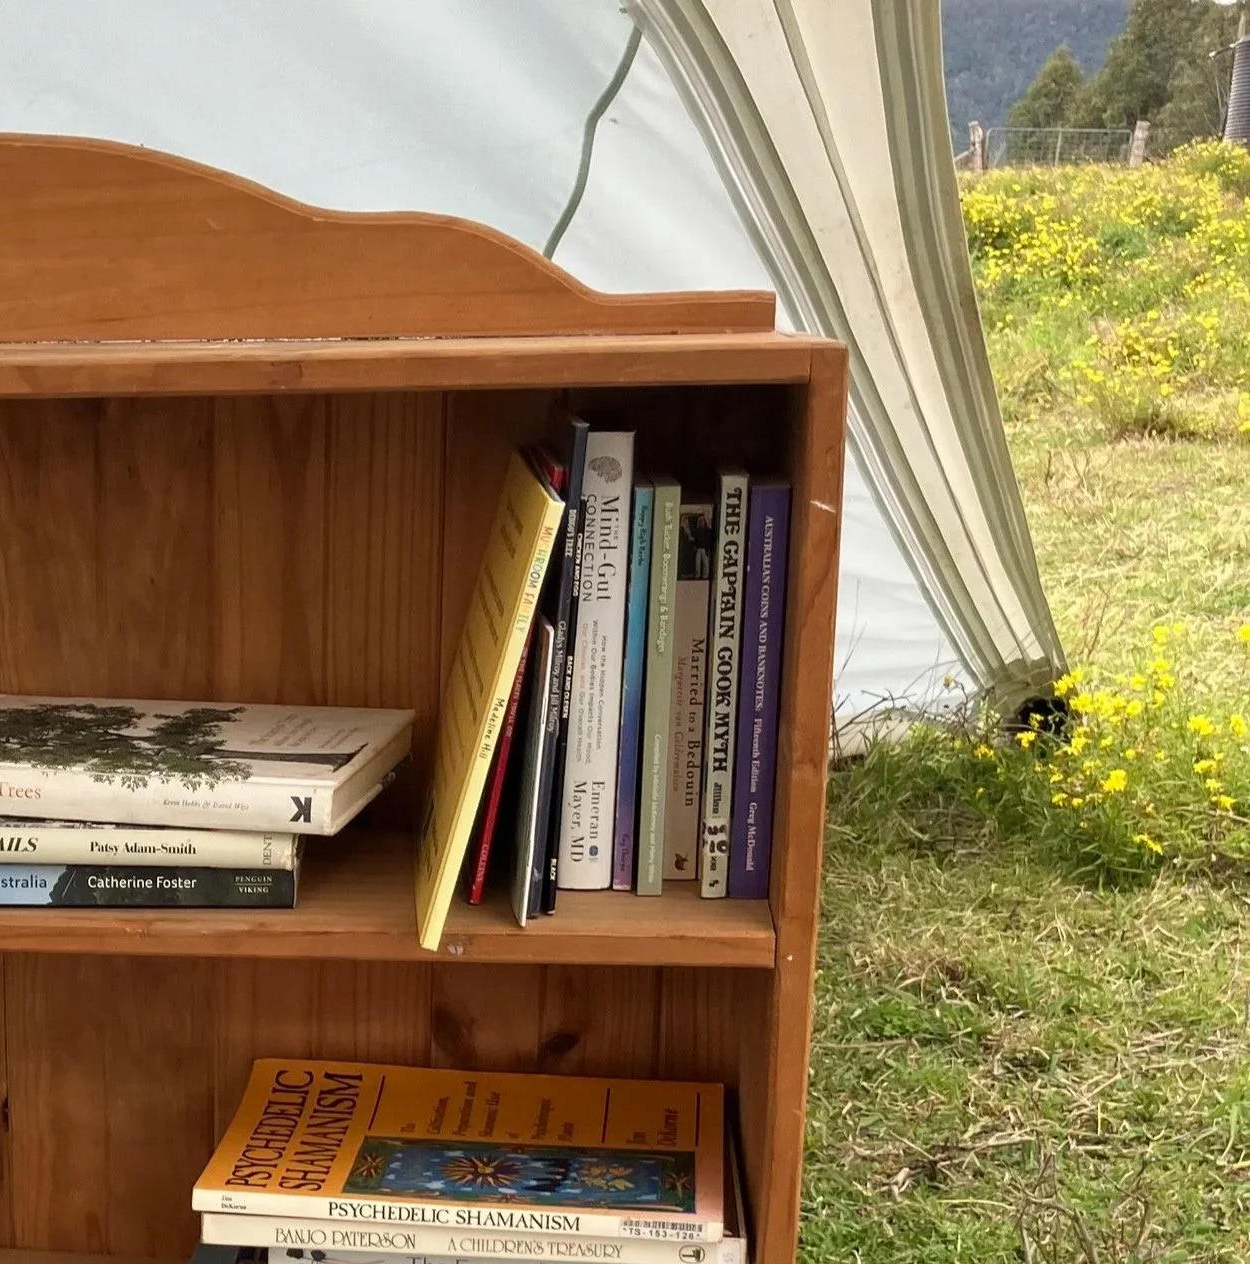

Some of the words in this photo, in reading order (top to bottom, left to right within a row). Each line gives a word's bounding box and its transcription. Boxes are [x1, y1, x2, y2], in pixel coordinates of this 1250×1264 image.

[724, 487, 743, 535] THE
[582, 494, 597, 602] CONNECTION
[597, 495, 620, 601] Mind-Gut
[762, 516, 774, 583] AUSTRALIAN
[718, 539, 739, 639] CAPTAIN
[760, 585, 770, 618] COINS
[758, 620, 768, 643] AND
[688, 638, 705, 706] Married
[714, 646, 734, 707] COOK
[755, 645, 767, 711] BANKNOTES:
[689, 711, 697, 724] to
[752, 718, 763, 757] Fifteenth
[712, 711, 731, 773] MYTH
[685, 739, 700, 807] Bedouin
[750, 758, 760, 793] Edition
[570, 780, 587, 831] Mayer,
[588, 780, 606, 839] Emeran
[747, 802, 757, 824] Greg
[90, 840, 119, 856] Patsy
[122, 842, 197, 855] Adam-Smith
[570, 836, 584, 862] MD
[745, 825, 756, 871] McDonald
[87, 876, 153, 889] Catherine
[156, 876, 197, 889] Foster
[234, 875, 273, 883] PENGUIN
[238, 886, 269, 894] VIKING
[225, 1069, 314, 1188] PSYCHEDELIC
[278, 1071, 363, 1191] SHAMANISM
[328, 1201, 449, 1224] PSYCHEDELIC
[455, 1210, 580, 1232] SHAMANISM
[275, 1228, 327, 1245] BANJO
[332, 1229, 416, 1250] PATERSON
[448, 1238, 458, 1251] A
[459, 1238, 544, 1255] CHILDREN'S
[548, 1242, 623, 1259] TREASURY
